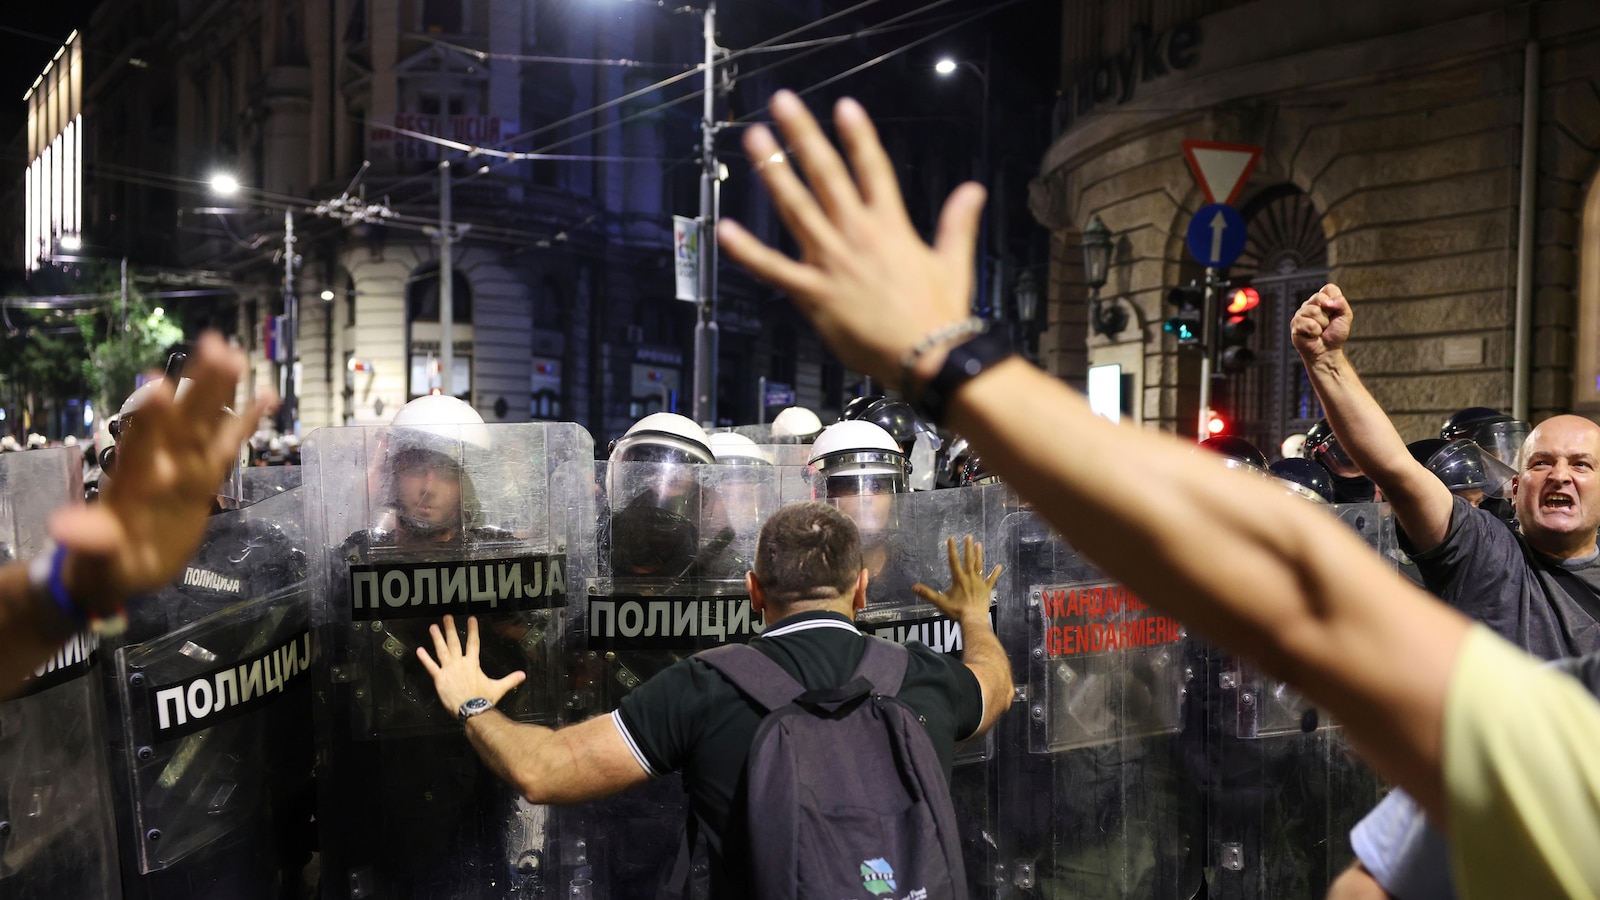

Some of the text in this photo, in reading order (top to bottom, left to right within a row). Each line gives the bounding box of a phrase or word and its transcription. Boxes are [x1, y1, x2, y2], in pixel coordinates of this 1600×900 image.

[183, 566, 241, 594] ПОЛИЦИЈА
[353, 559, 566, 609] ПОЛИЦИЈА
[590, 600, 768, 643] ПОЛИЦИЈ
